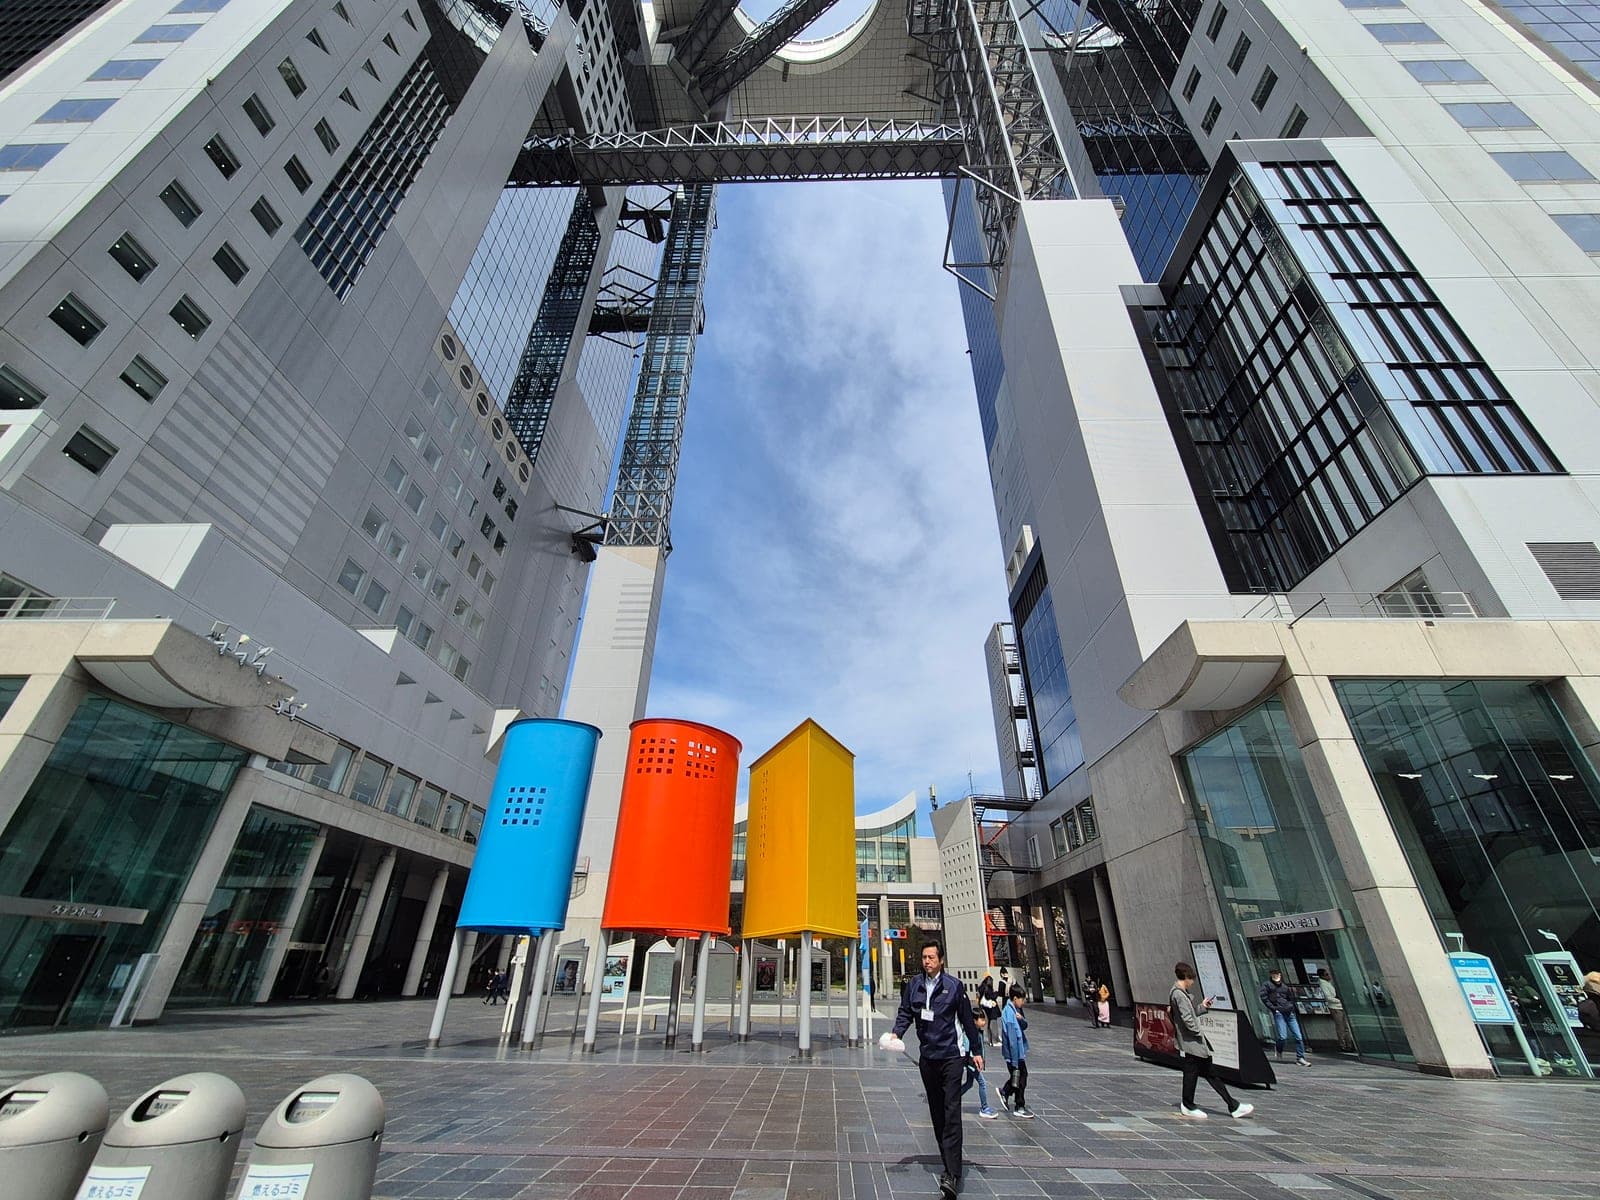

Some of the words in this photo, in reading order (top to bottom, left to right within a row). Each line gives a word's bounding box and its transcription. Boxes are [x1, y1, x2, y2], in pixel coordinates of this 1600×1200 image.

[87, 1184, 135, 1198] 燃えるゴミ
[252, 1183, 300, 1196] 燃えるゴミ
